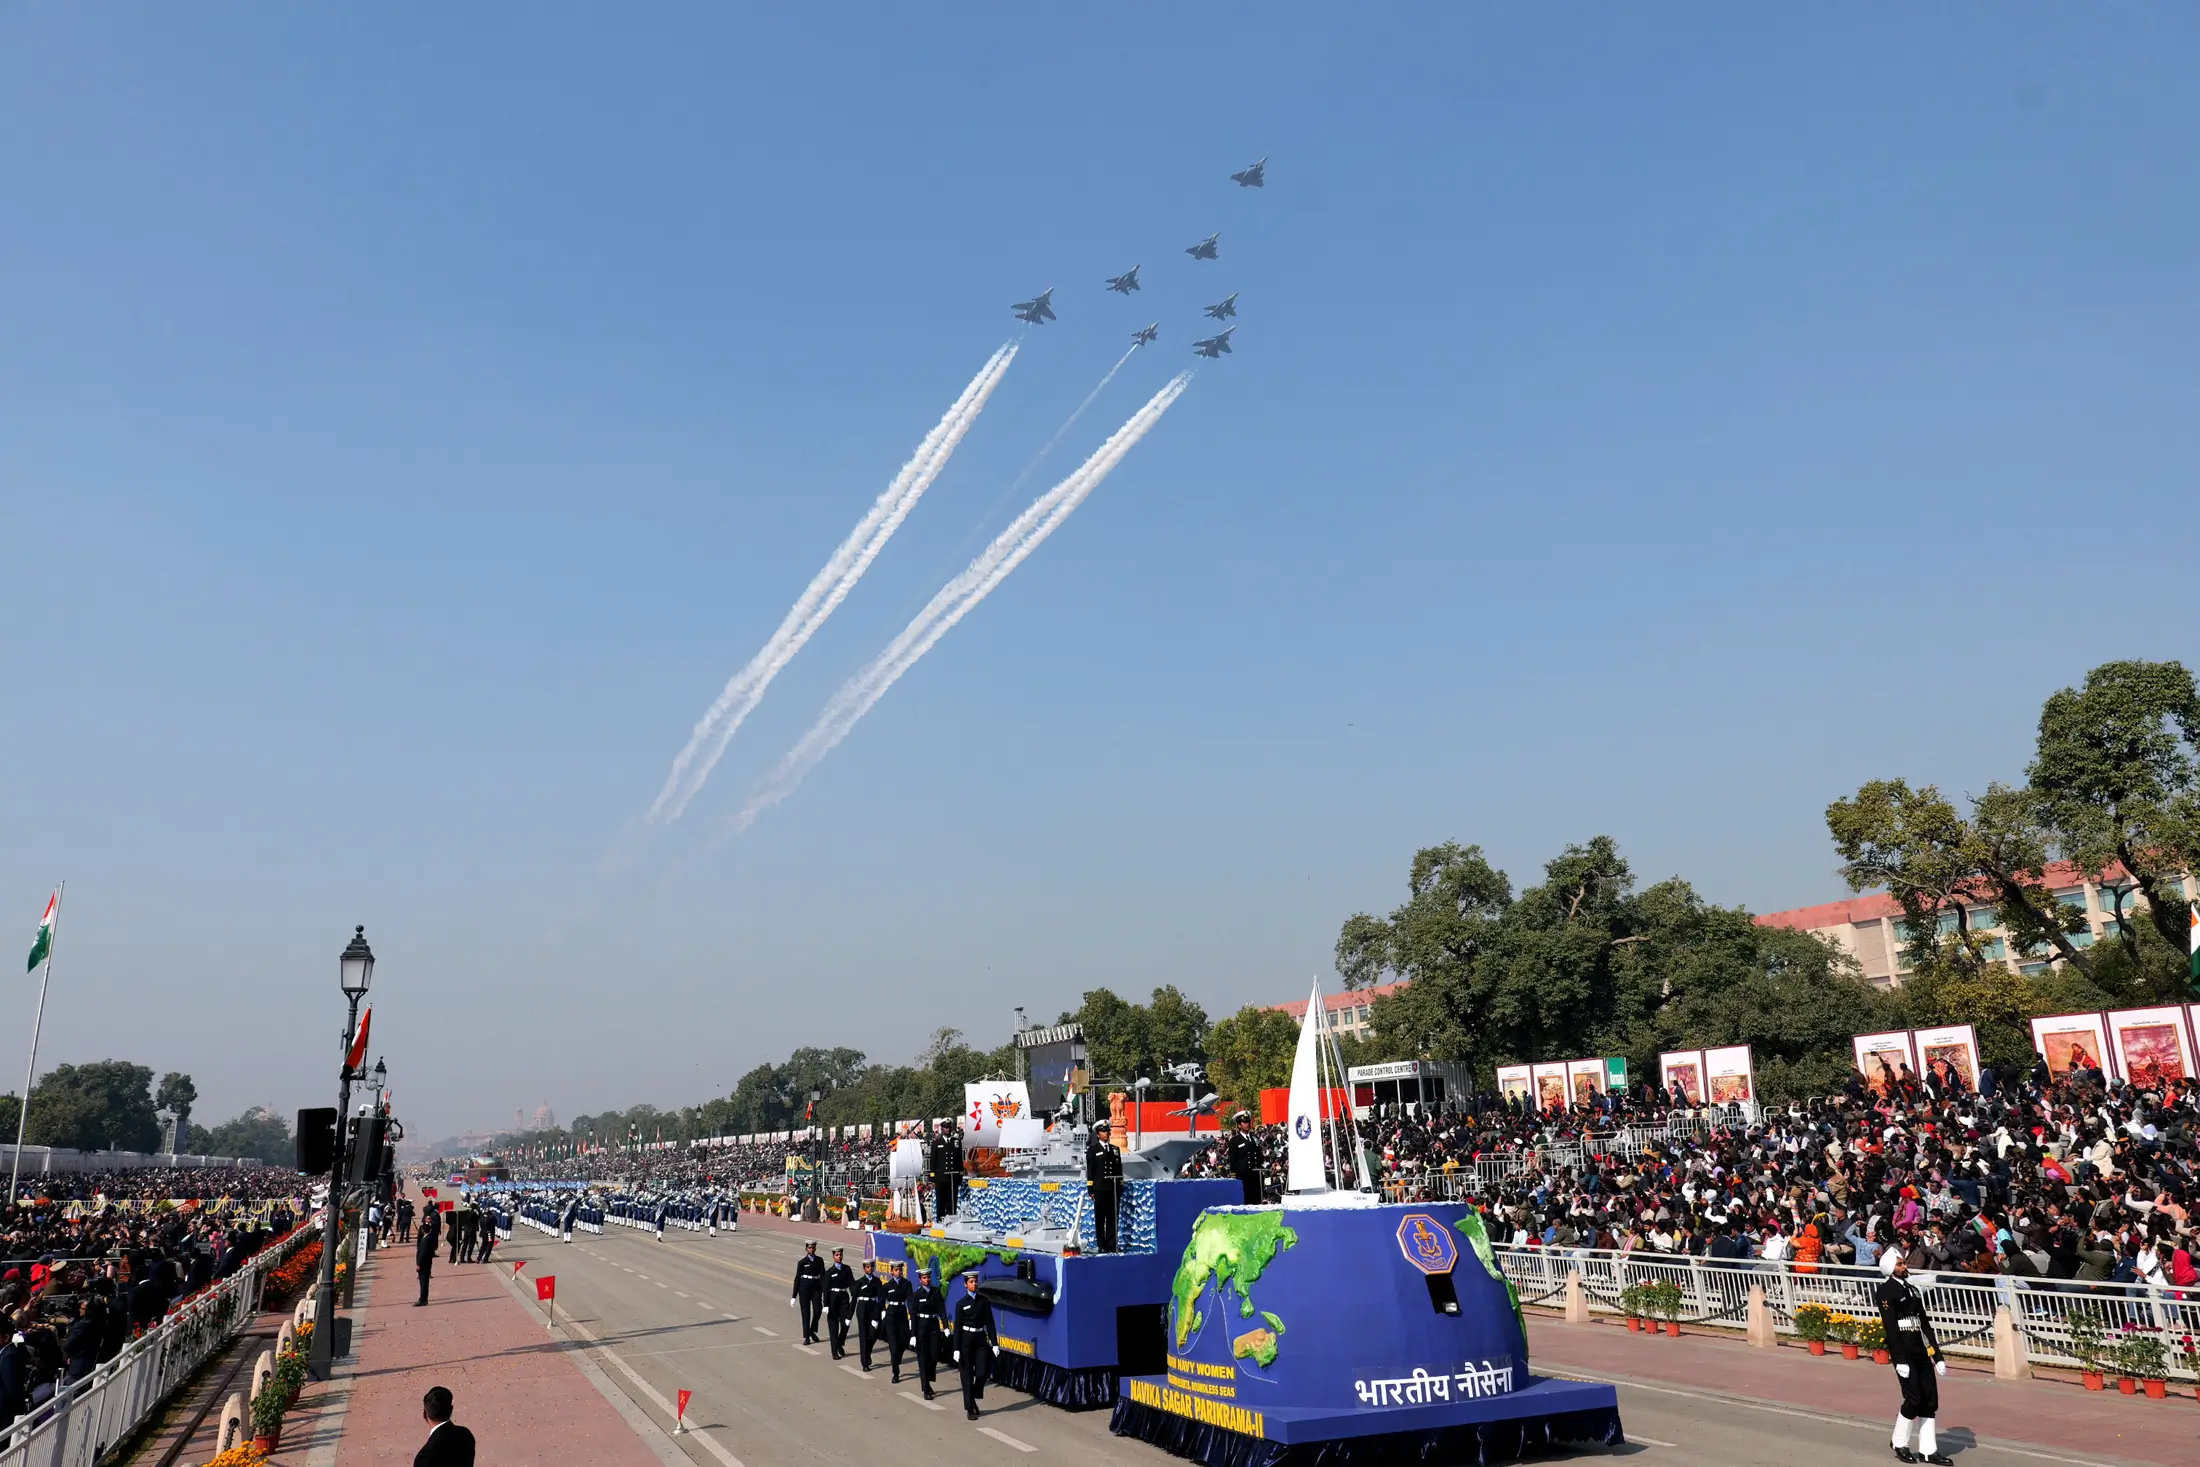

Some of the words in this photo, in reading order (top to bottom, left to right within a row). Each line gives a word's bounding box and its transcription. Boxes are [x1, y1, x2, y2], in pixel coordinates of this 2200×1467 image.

[1357, 1068, 1374, 1077] PARADE
[1374, 1066, 1394, 1076] CONTROL
[1394, 1063, 1411, 1074] CENTRE
[1177, 1358, 1195, 1374] NAVY
[1196, 1363, 1235, 1380] WOMEN
[1219, 1386, 1235, 1398] SEAS
[1354, 1367, 1450, 1406] भारतीय
[1455, 1360, 1513, 1399] नौसेना
[1131, 1379, 1161, 1409] NAVIKA
[1162, 1387, 1194, 1419] SAGAR
[1194, 1396, 1264, 1439] PARIKRAMA-II
